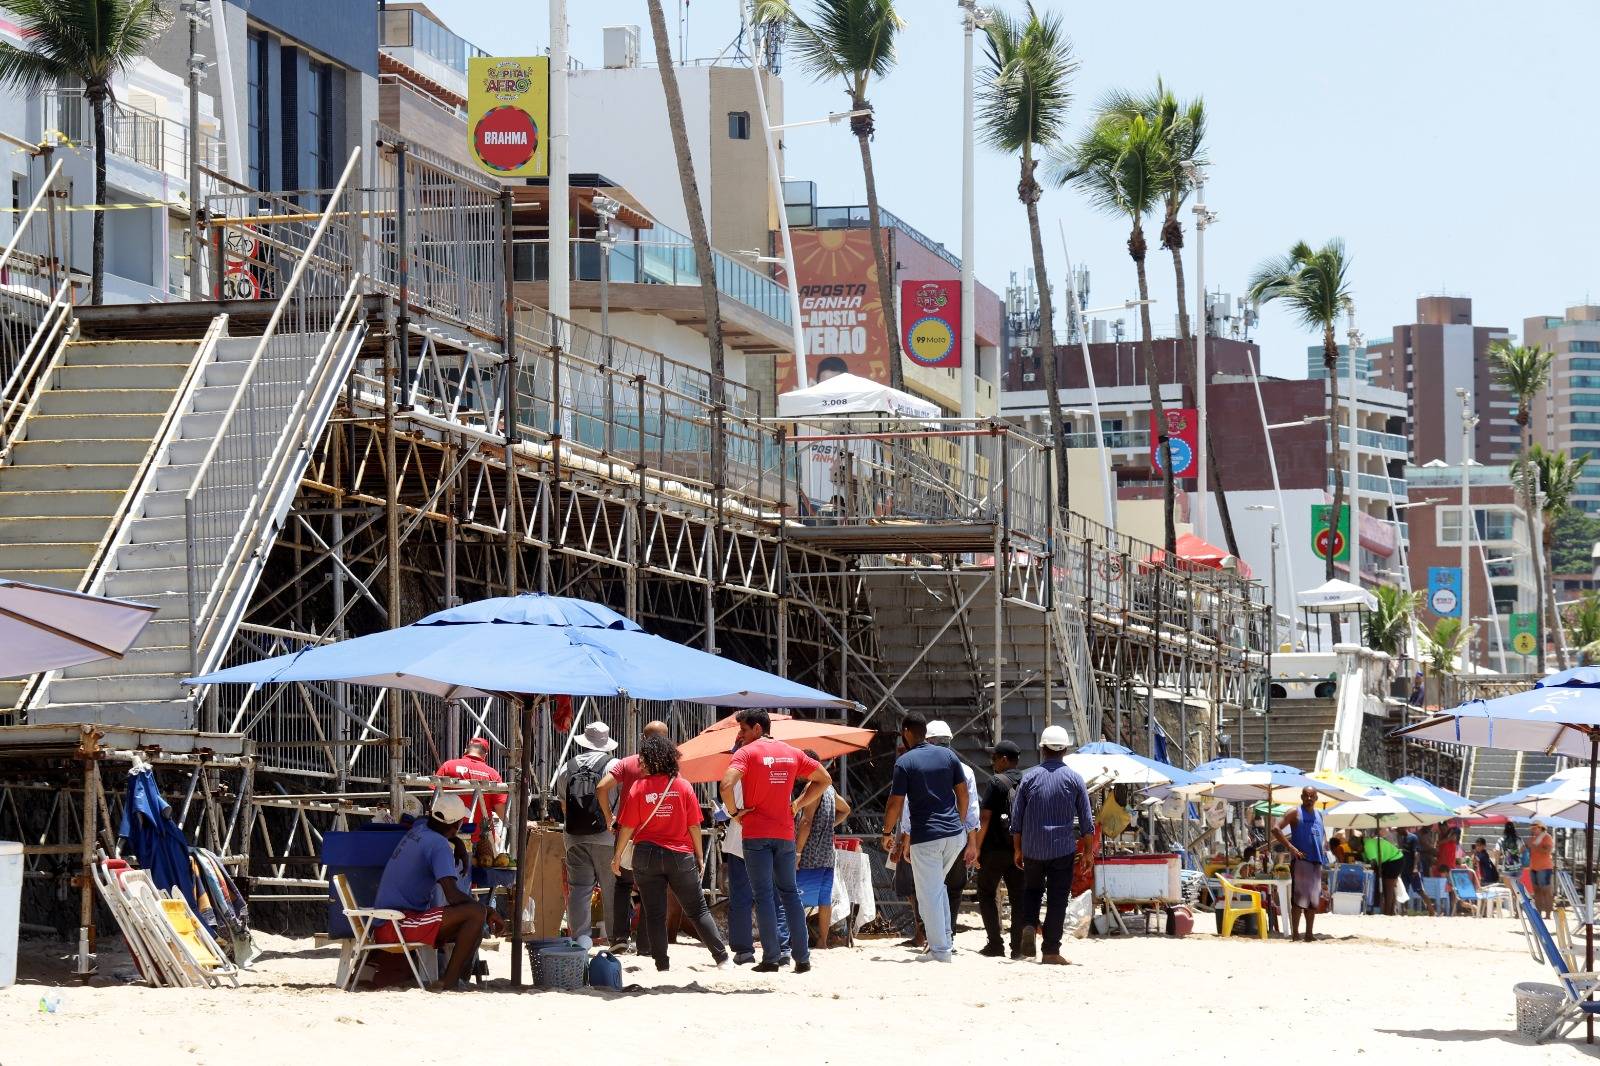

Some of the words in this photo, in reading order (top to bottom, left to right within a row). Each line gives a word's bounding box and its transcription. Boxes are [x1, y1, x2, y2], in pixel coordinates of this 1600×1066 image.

[487, 80, 529, 93] AFRO
[484, 131, 528, 145] BRAHMA
[799, 284, 867, 298] APOSTA
[802, 296, 862, 309] GANHA
[810, 310, 857, 326] APOSTA
[802, 326, 867, 355] VERÃO
[916, 336, 926, 344] 99
[926, 336, 946, 344] Moto
